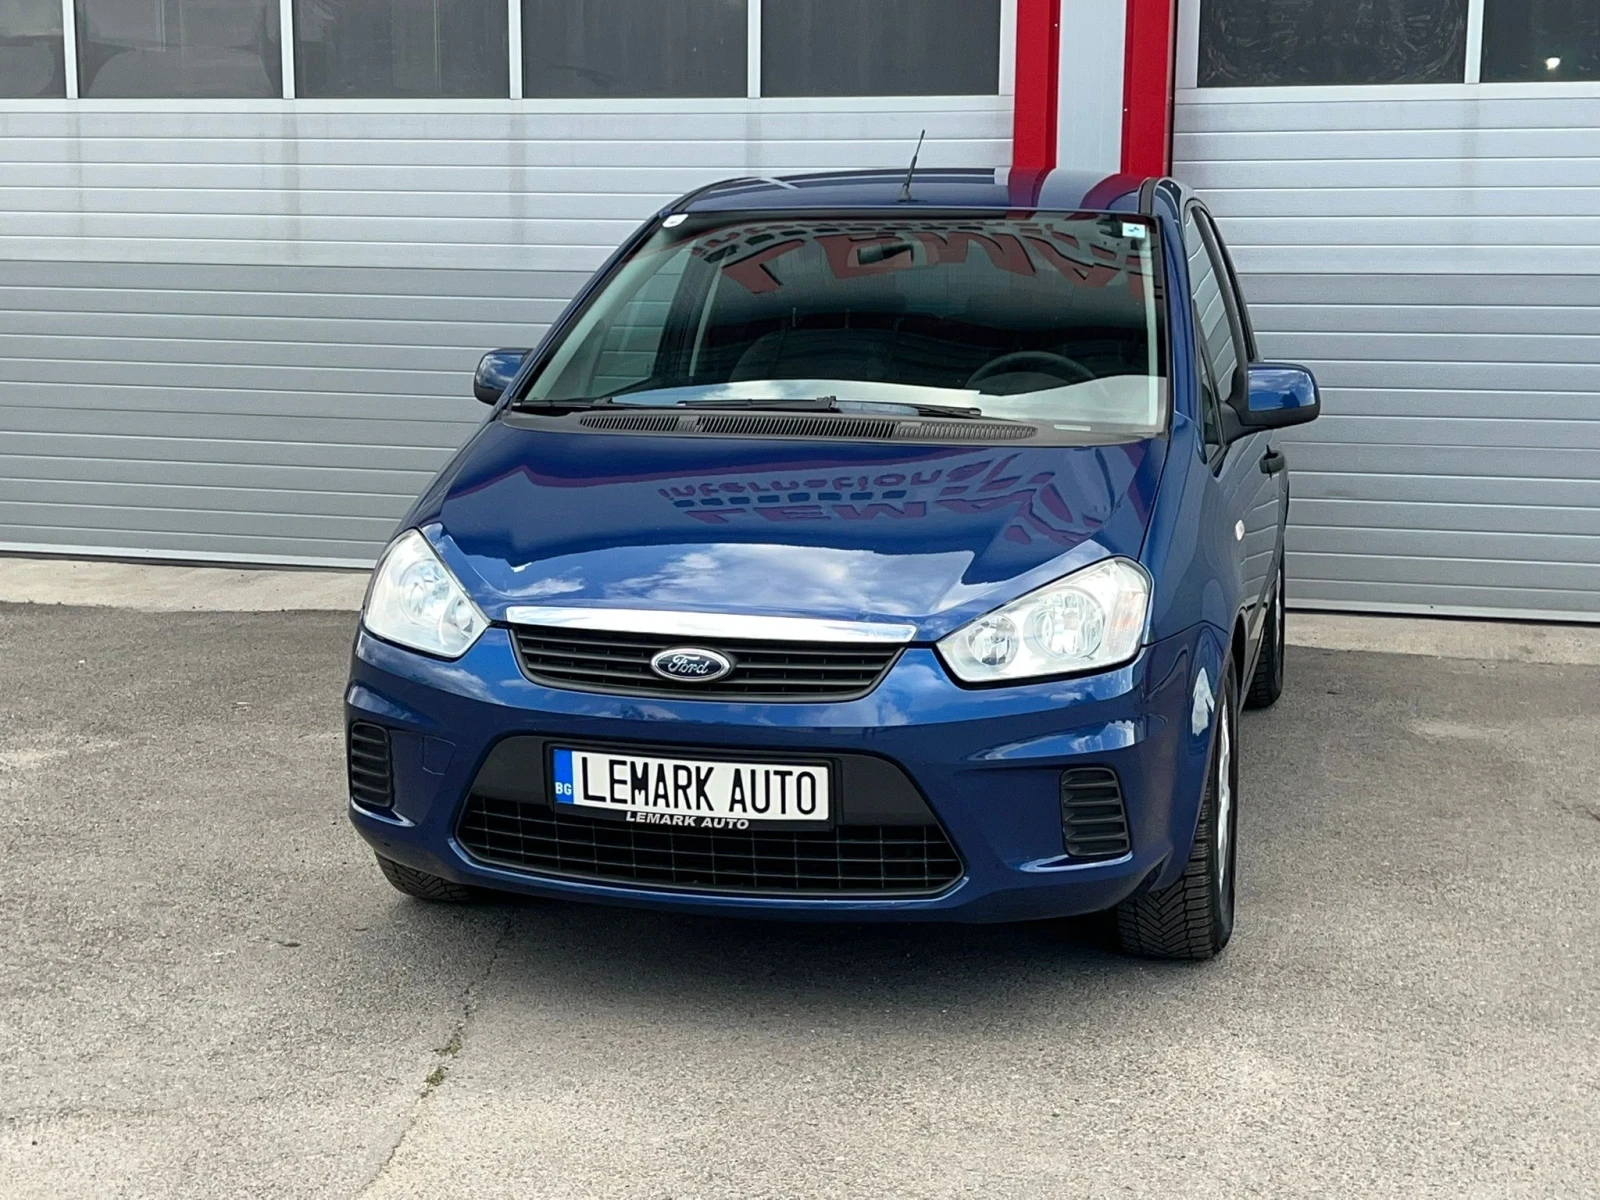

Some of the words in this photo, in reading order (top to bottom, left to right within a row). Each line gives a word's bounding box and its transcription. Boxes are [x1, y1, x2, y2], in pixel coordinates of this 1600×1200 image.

[667, 655, 709, 675] Ford
[555, 781, 572, 796] BG
[581, 756, 715, 812] LEMARK
[728, 768, 816, 816] AUTO
[625, 811, 696, 828] LEMARK
[700, 816, 750, 831] AUTO
